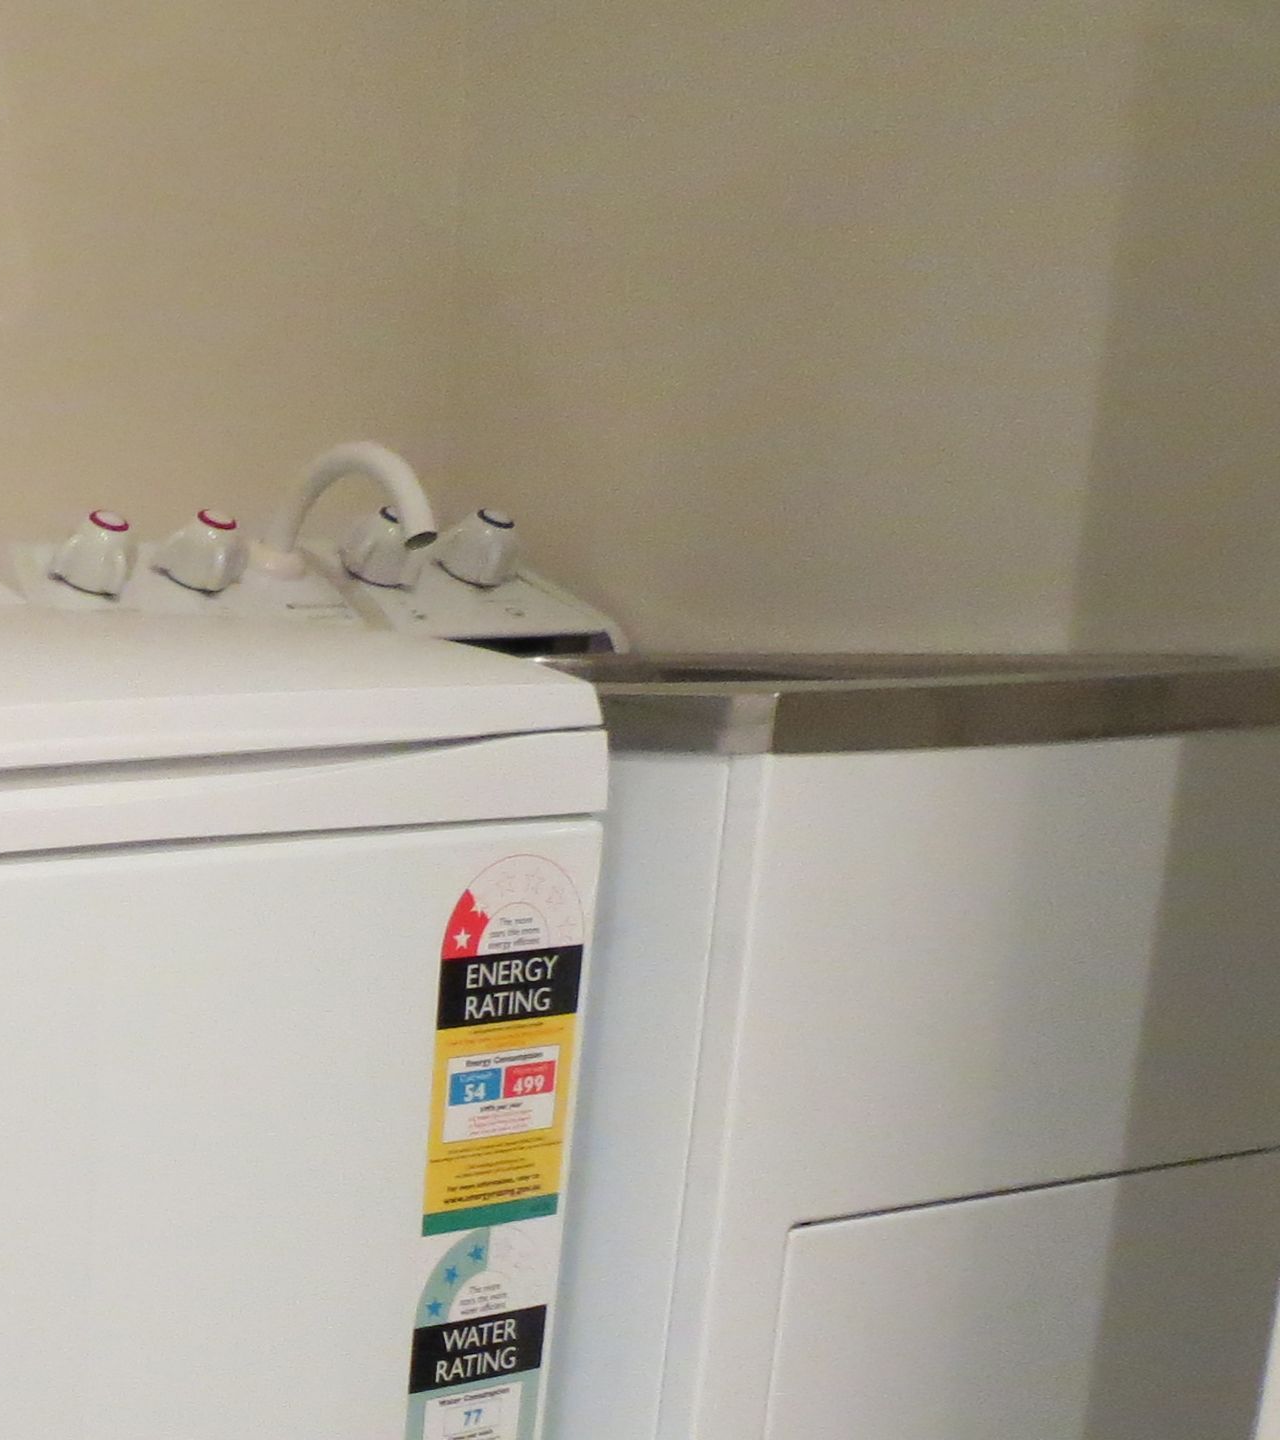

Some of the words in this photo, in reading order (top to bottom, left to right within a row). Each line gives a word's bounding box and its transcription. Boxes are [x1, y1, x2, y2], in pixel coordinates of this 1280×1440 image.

[466, 955, 559, 990] ENERGY
[464, 987, 552, 1021] RATING
[463, 1082, 487, 1102] 54
[512, 1074, 546, 1096] 499
[442, 1318, 517, 1353] WATER
[435, 1346, 517, 1384] RATING
[463, 1407, 483, 1427] 77
